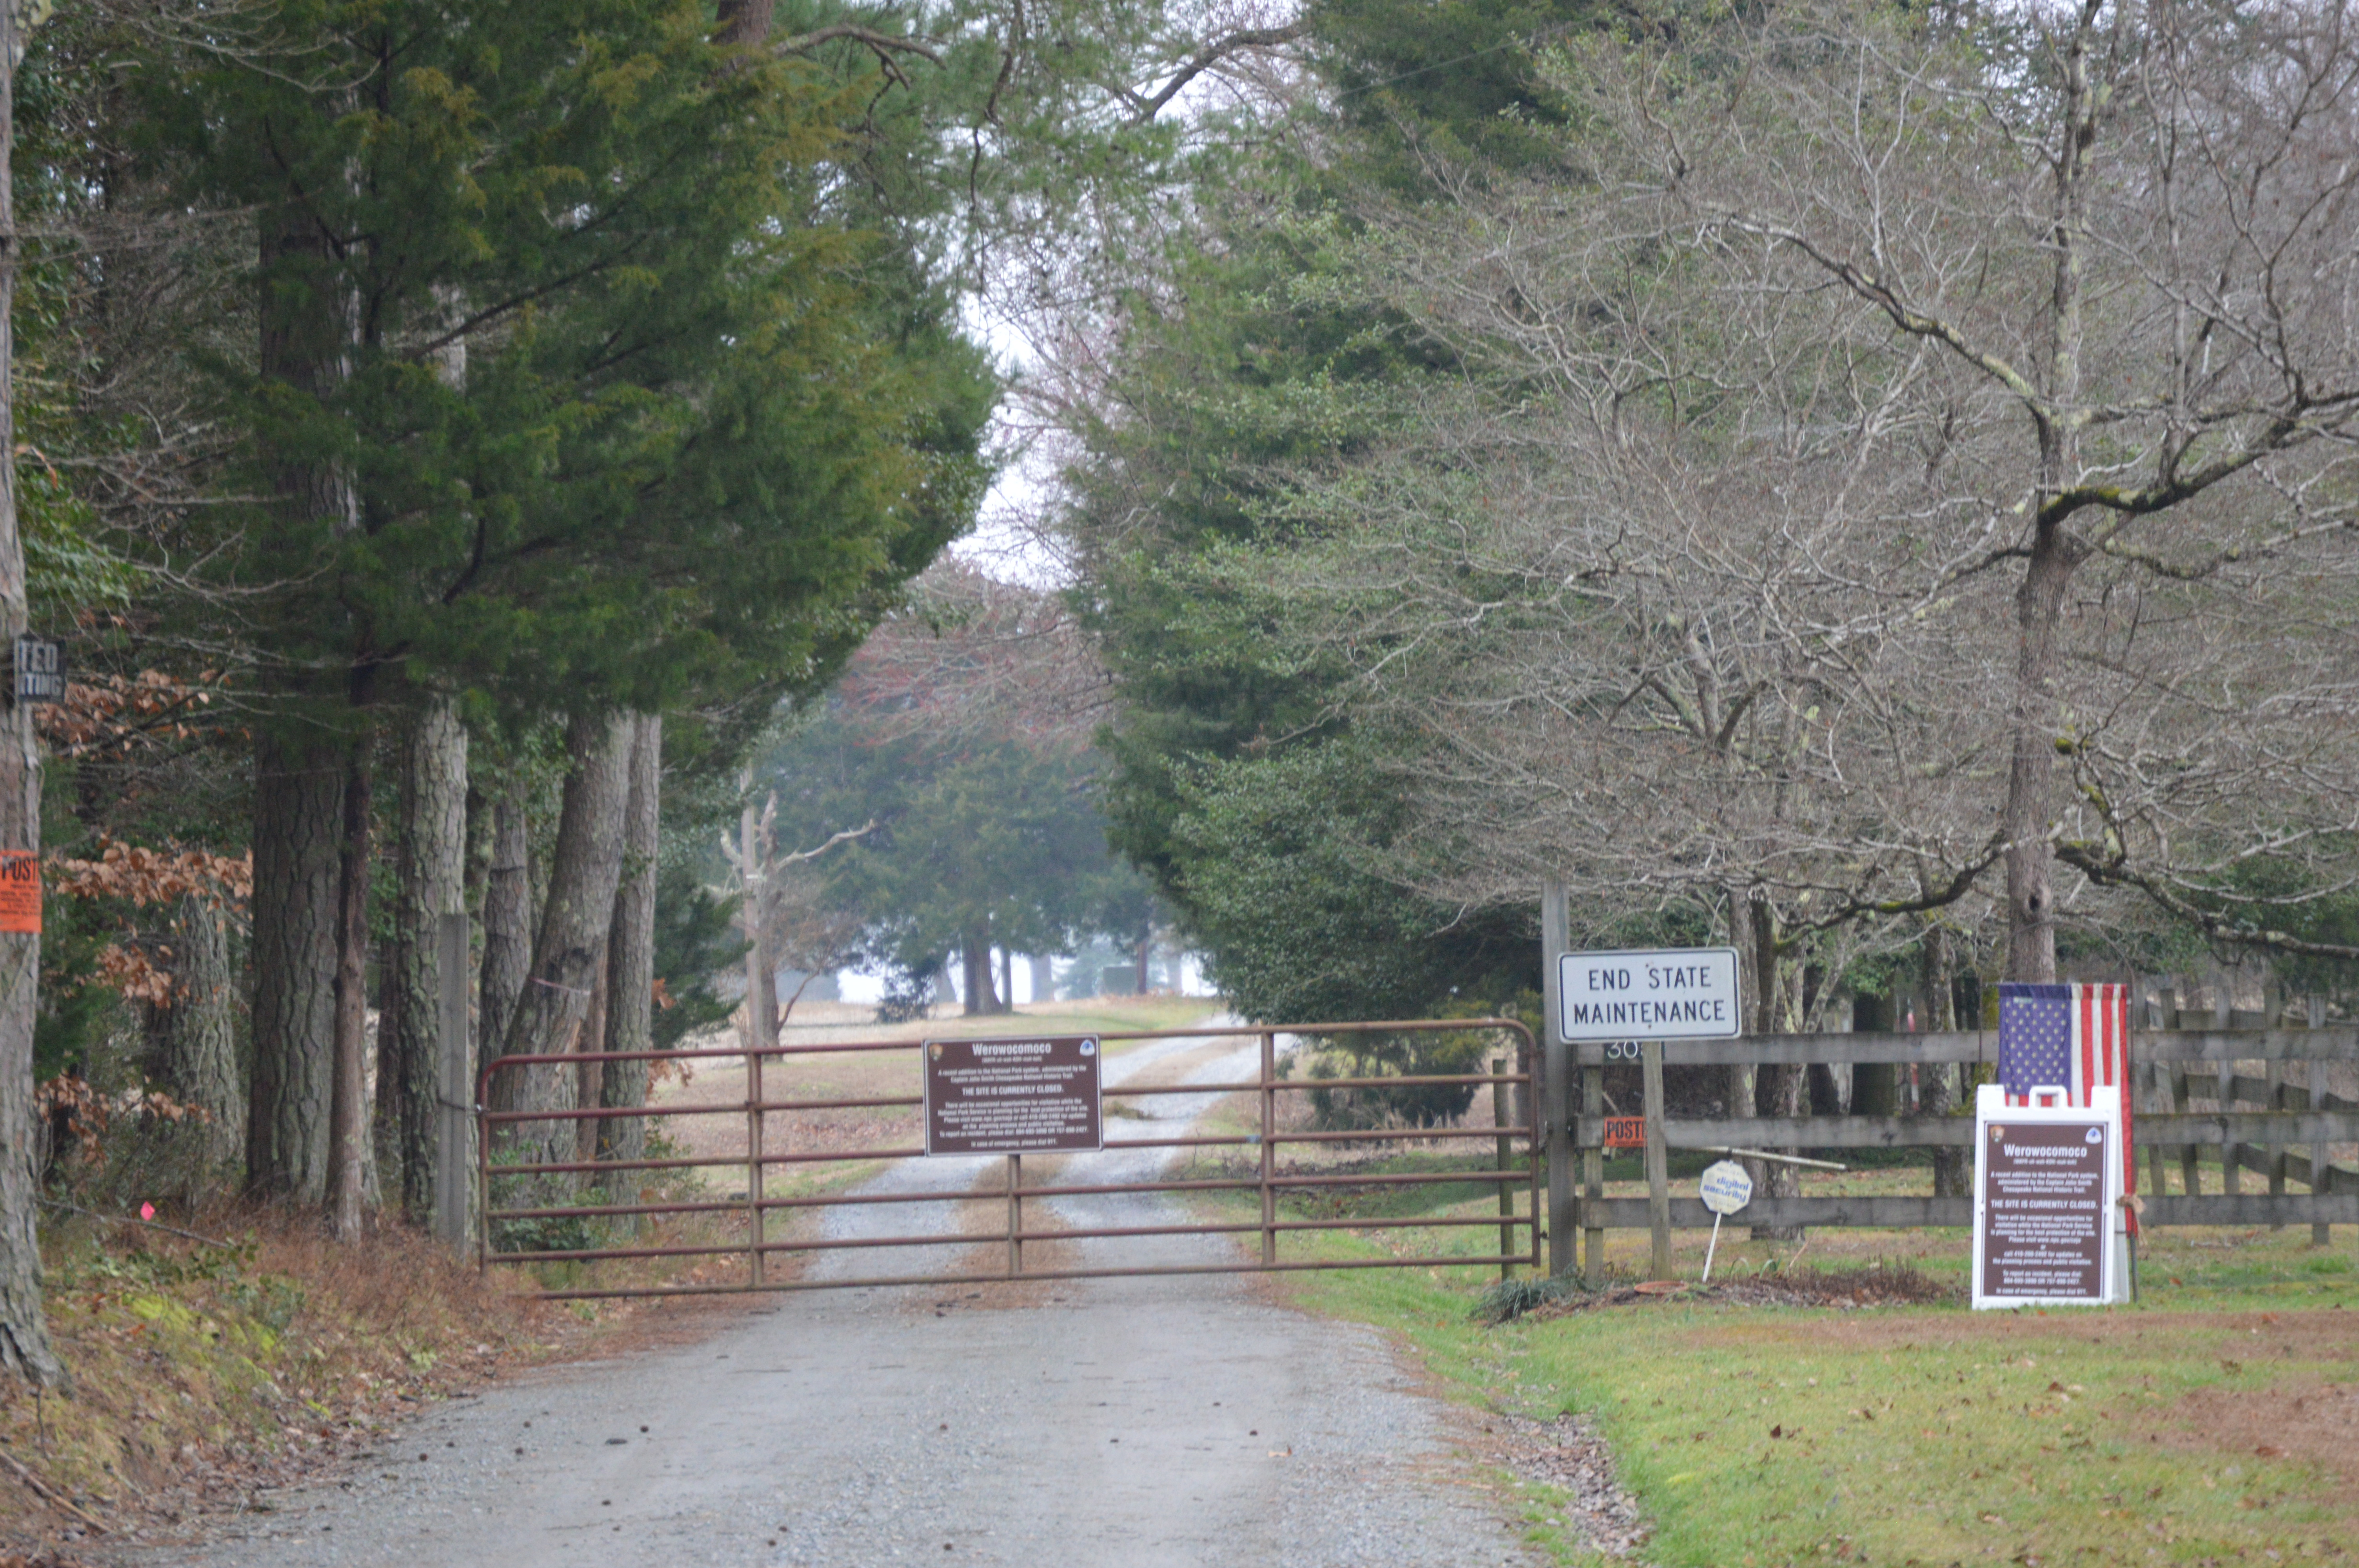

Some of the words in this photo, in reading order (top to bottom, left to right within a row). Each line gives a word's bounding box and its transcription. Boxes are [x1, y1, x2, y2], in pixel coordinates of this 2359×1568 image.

[2, 856, 38, 880] POST
[1589, 969, 1630, 990] END
[1648, 966, 1711, 989] STATE
[1574, 1000, 1725, 1024] MAINTENANCE
[972, 1043, 1052, 1056] Werowocomoco
[1608, 1041, 1643, 1059] 30
[963, 1087, 974, 1096] THE
[976, 1087, 989, 1095] SITE
[991, 1086, 997, 1095] IS
[999, 1086, 1036, 1094] CURRENTLY
[2004, 1143, 2087, 1157] Werowocomoco
[1717, 1176, 1749, 1191] digital
[1704, 1185, 1746, 1203] security
[1991, 1200, 2003, 1208] THE
[2005, 1200, 2019, 1208] SITE
[2021, 1200, 2028, 1208] IS
[2029, 1200, 2068, 1209] CURRENTLY
[2070, 1200, 2098, 1209] CLOSED.
